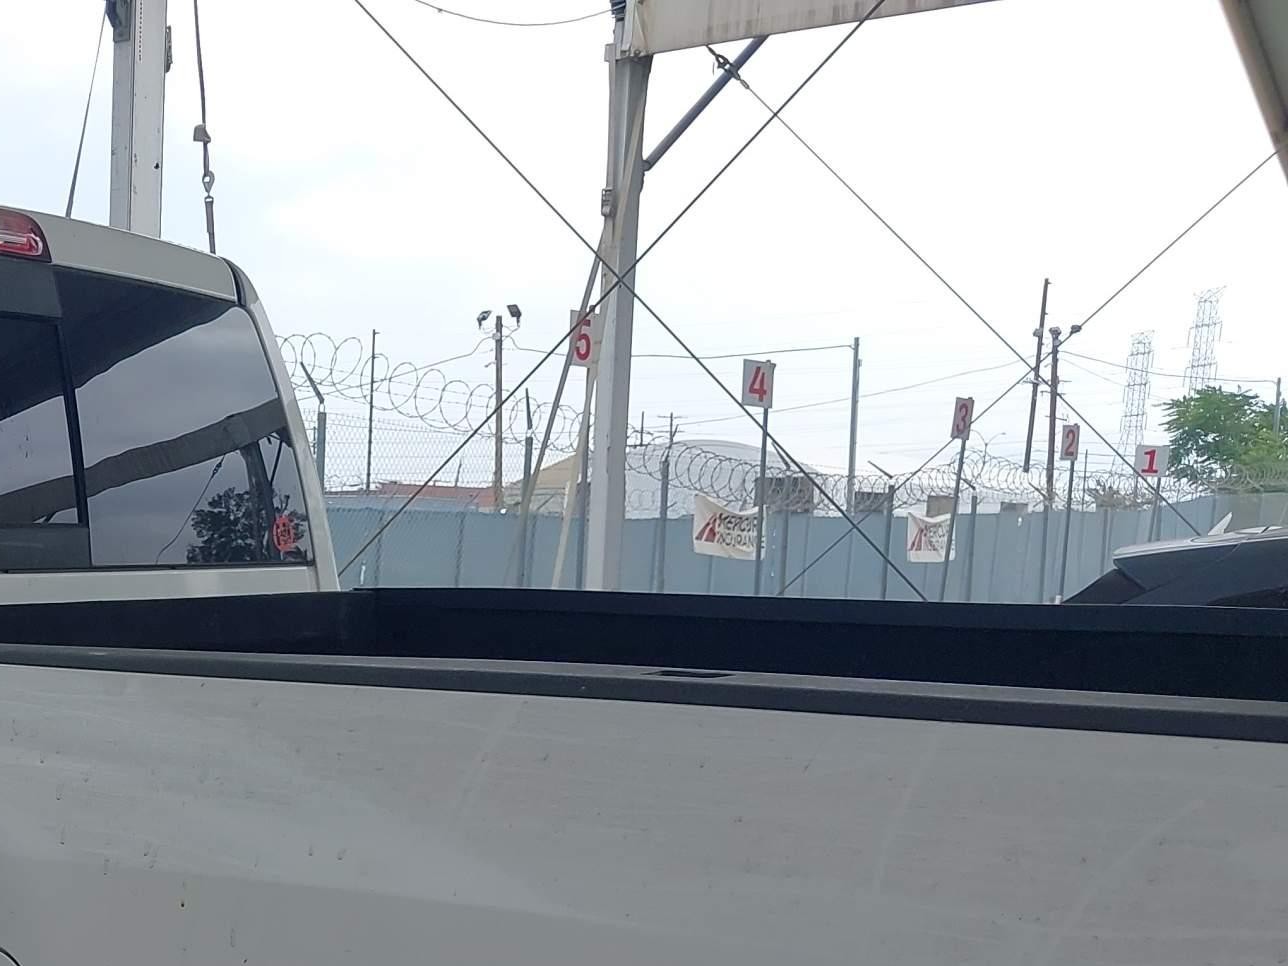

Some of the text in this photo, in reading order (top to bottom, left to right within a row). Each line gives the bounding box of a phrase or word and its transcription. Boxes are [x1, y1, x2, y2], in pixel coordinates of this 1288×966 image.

[575, 319, 591, 361] 5
[749, 366, 767, 402] 4
[956, 403, 968, 435] 3
[1064, 429, 1075, 456] 2
[1141, 449, 1158, 473] 1
[716, 512, 759, 533] MERCUR
